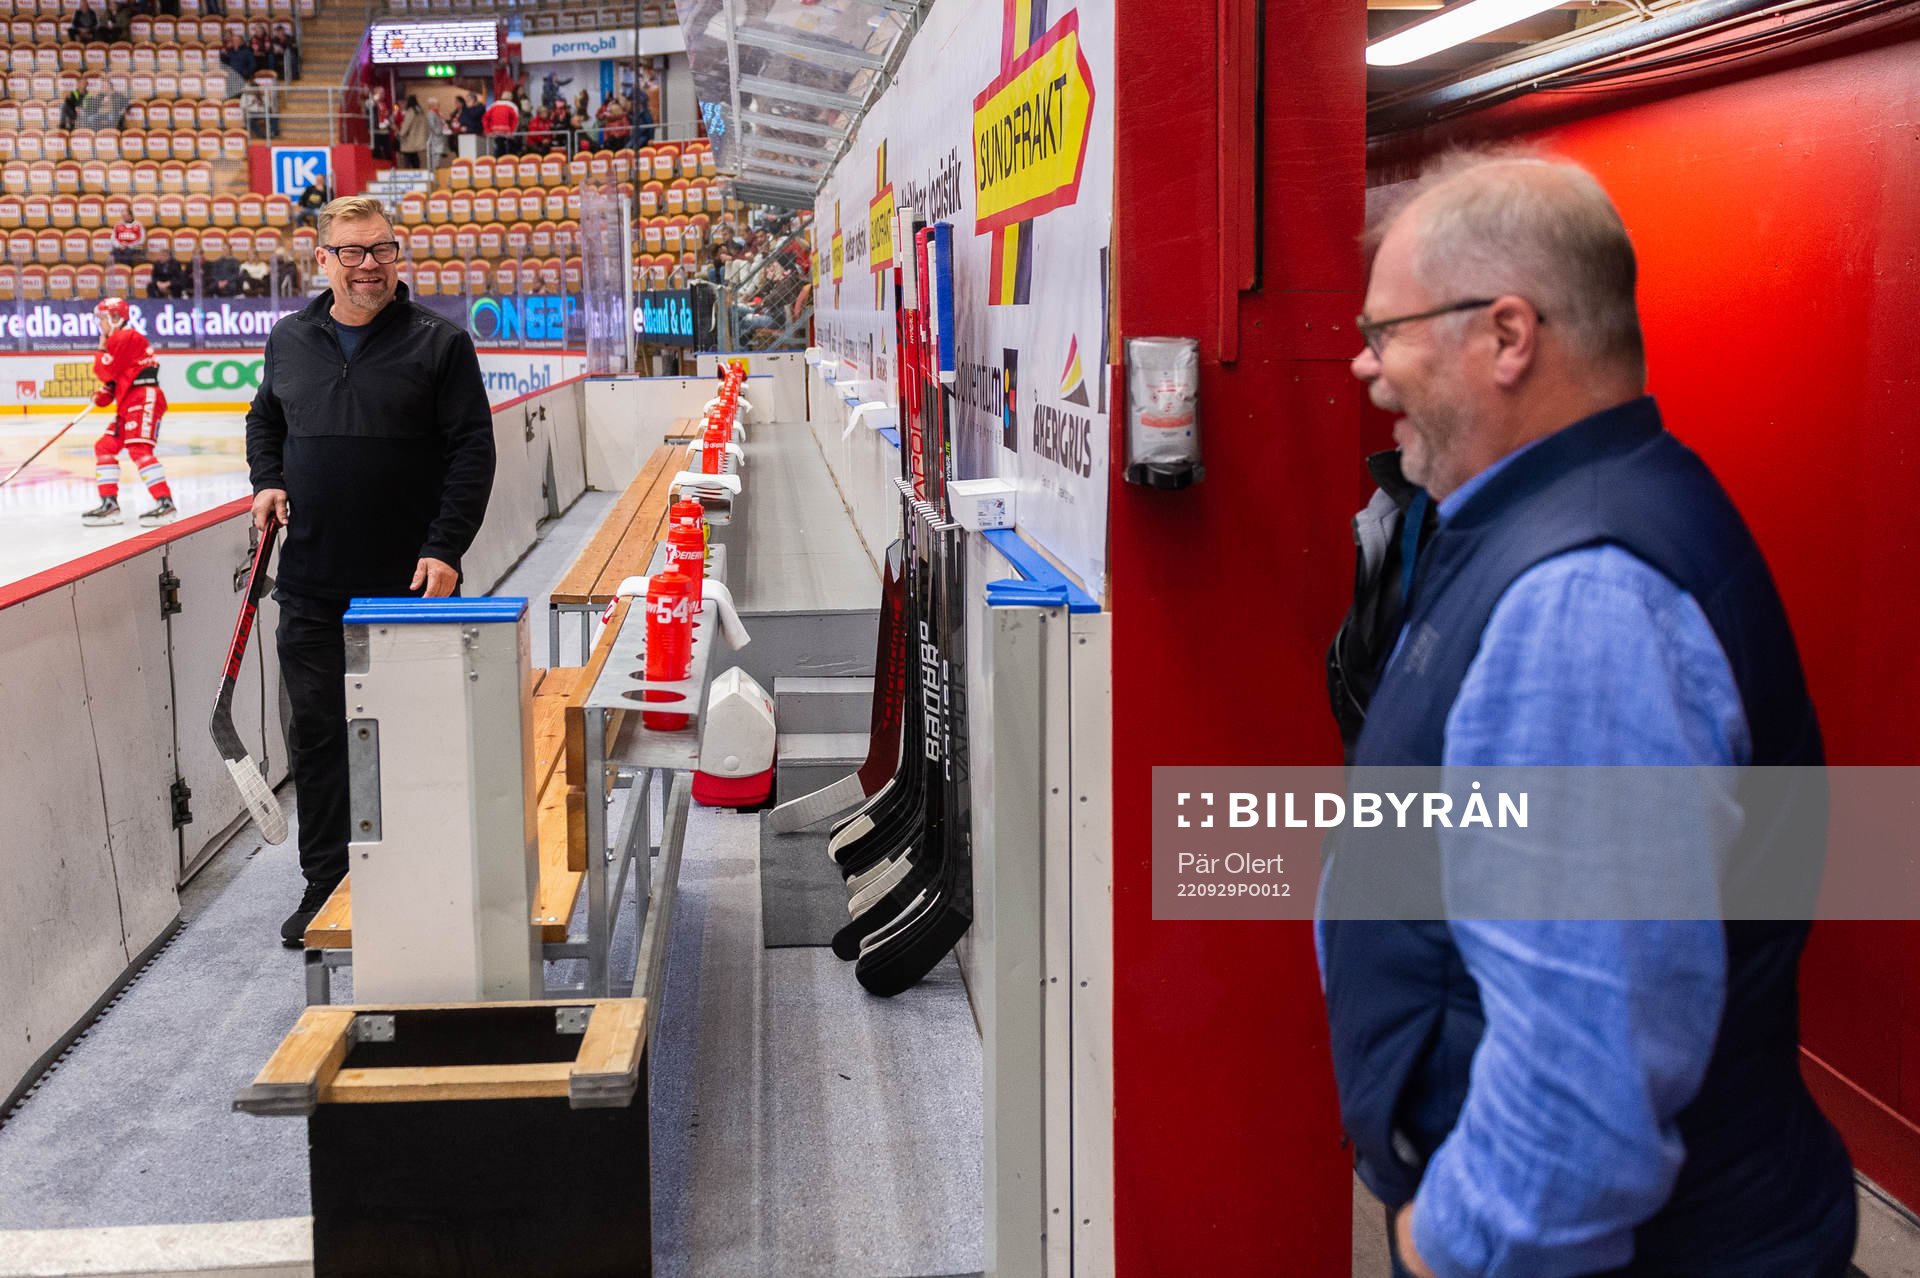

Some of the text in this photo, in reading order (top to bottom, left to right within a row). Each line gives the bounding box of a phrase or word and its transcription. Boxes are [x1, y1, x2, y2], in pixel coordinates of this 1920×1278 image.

[552, 35, 617, 57] permobil
[979, 73, 1067, 191] SUNDFRAKT
[282, 156, 320, 195] LK
[928, 145, 962, 225] logistik
[0, 305, 102, 338] redban
[1033, 388, 1092, 479] ÅKERIGRUS
[656, 596, 690, 624] 54
[925, 643, 941, 763] BAUER
